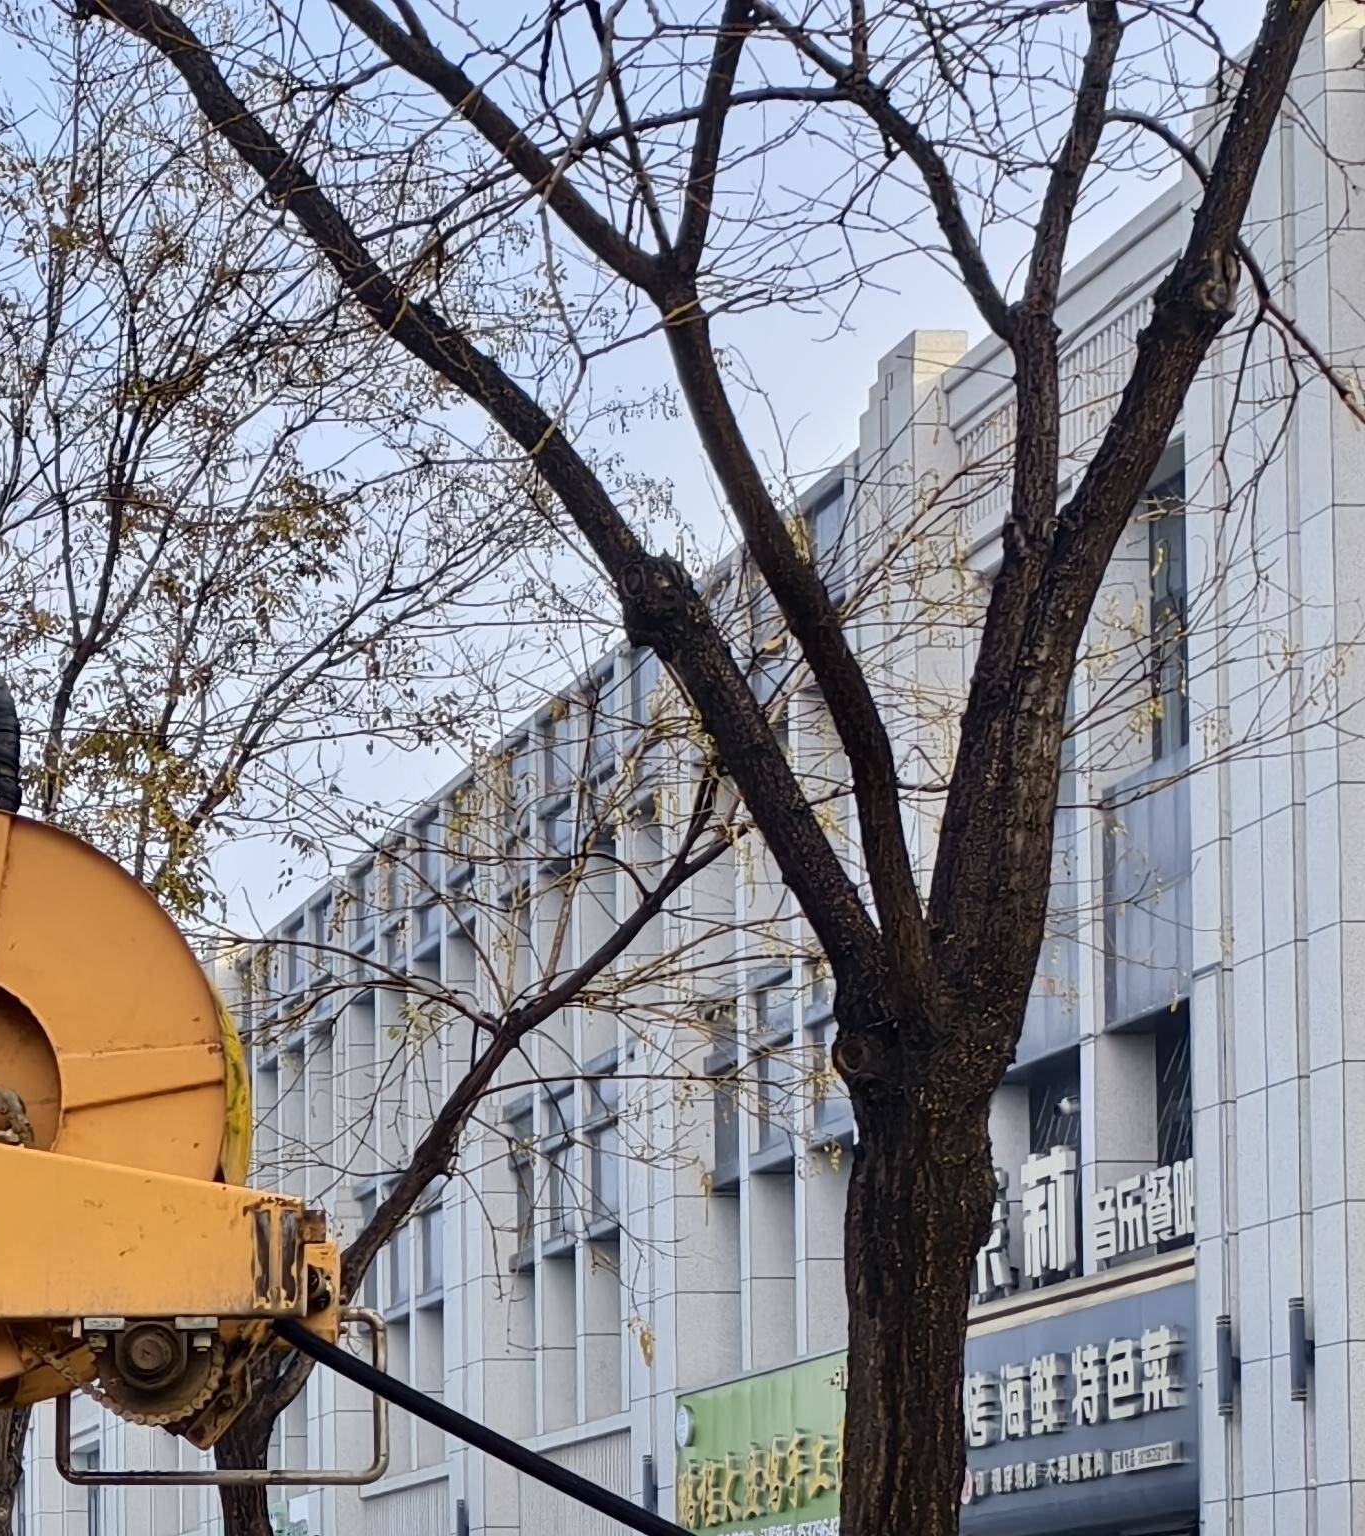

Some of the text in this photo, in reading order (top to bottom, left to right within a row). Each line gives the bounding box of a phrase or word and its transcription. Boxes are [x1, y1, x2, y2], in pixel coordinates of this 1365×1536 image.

[1093, 1157, 1195, 1261] 音乐餐吧
[1072, 1325, 1181, 1426] 特色菜
